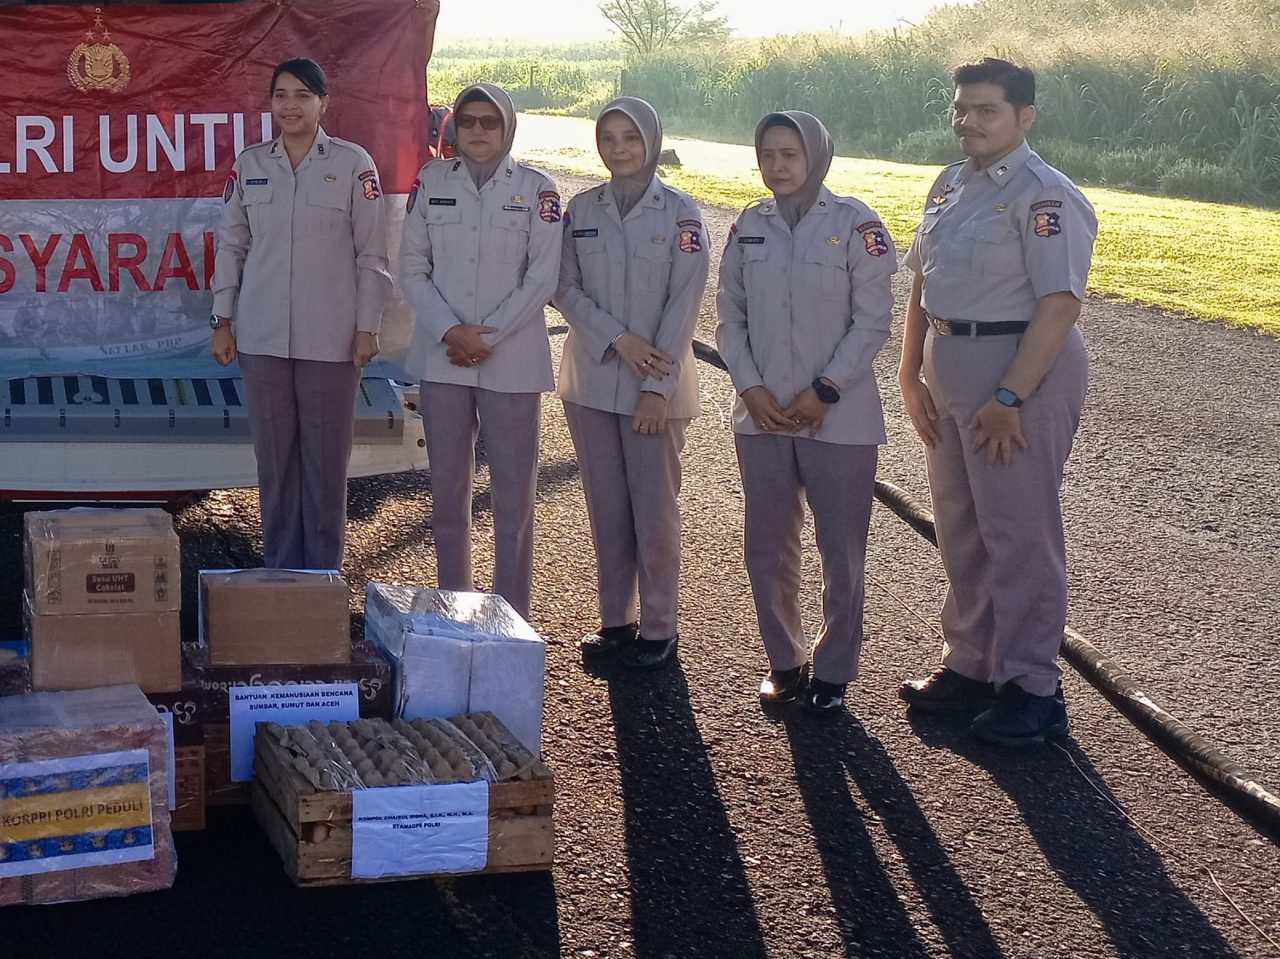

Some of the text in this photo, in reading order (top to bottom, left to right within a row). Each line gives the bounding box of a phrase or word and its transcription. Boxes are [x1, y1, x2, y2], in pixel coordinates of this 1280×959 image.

[99, 112, 273, 173] UNTU
[112, 574, 129, 582] UHT
[270, 692, 319, 700] KEMANUSIAAN
[321, 690, 353, 698] BENCANA
[321, 700, 340, 708] ACEH
[2, 800, 143, 827] KORPRI POLRI PEDULI
